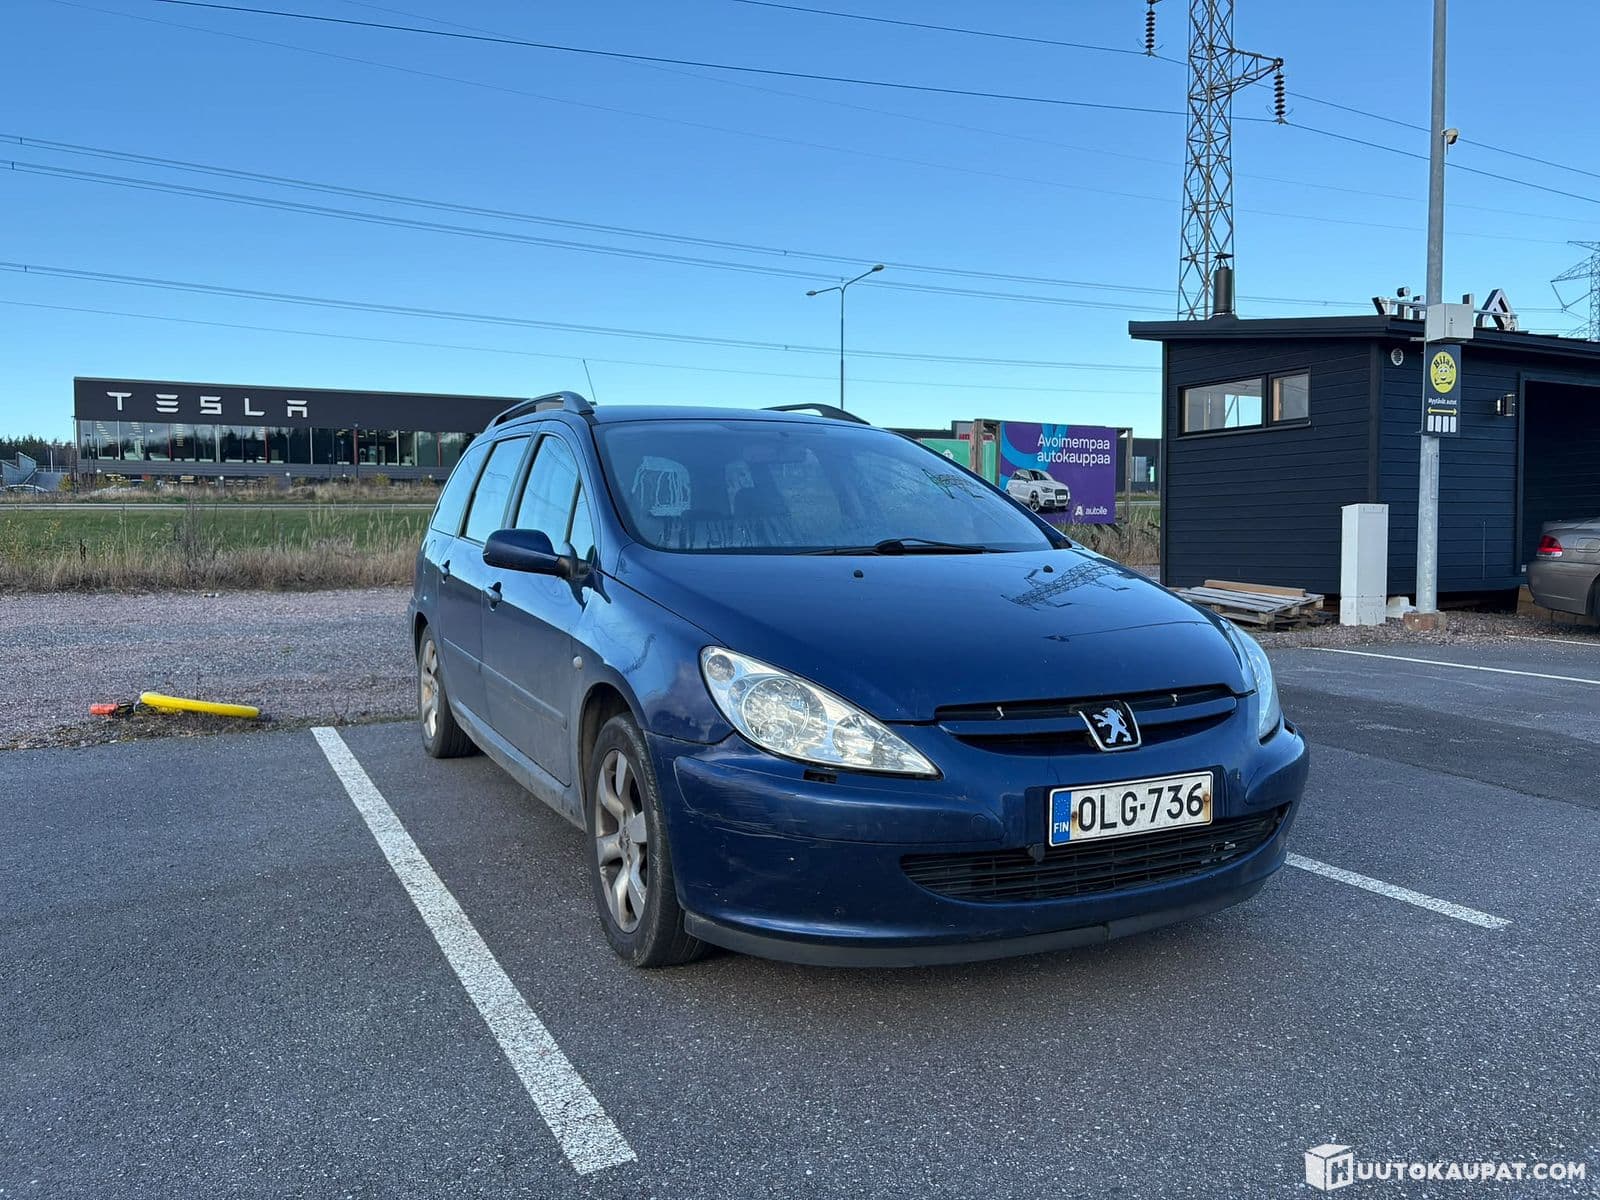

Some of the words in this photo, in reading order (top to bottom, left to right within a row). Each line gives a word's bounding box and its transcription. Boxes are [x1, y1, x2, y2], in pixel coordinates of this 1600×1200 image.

[106, 391, 309, 418] TESLA
[1037, 433, 1110, 450] Avoimempaa
[1037, 449, 1111, 467] autokauppaa
[1077, 782, 1205, 832] OLG-736
[1053, 821, 1069, 834] FIN
